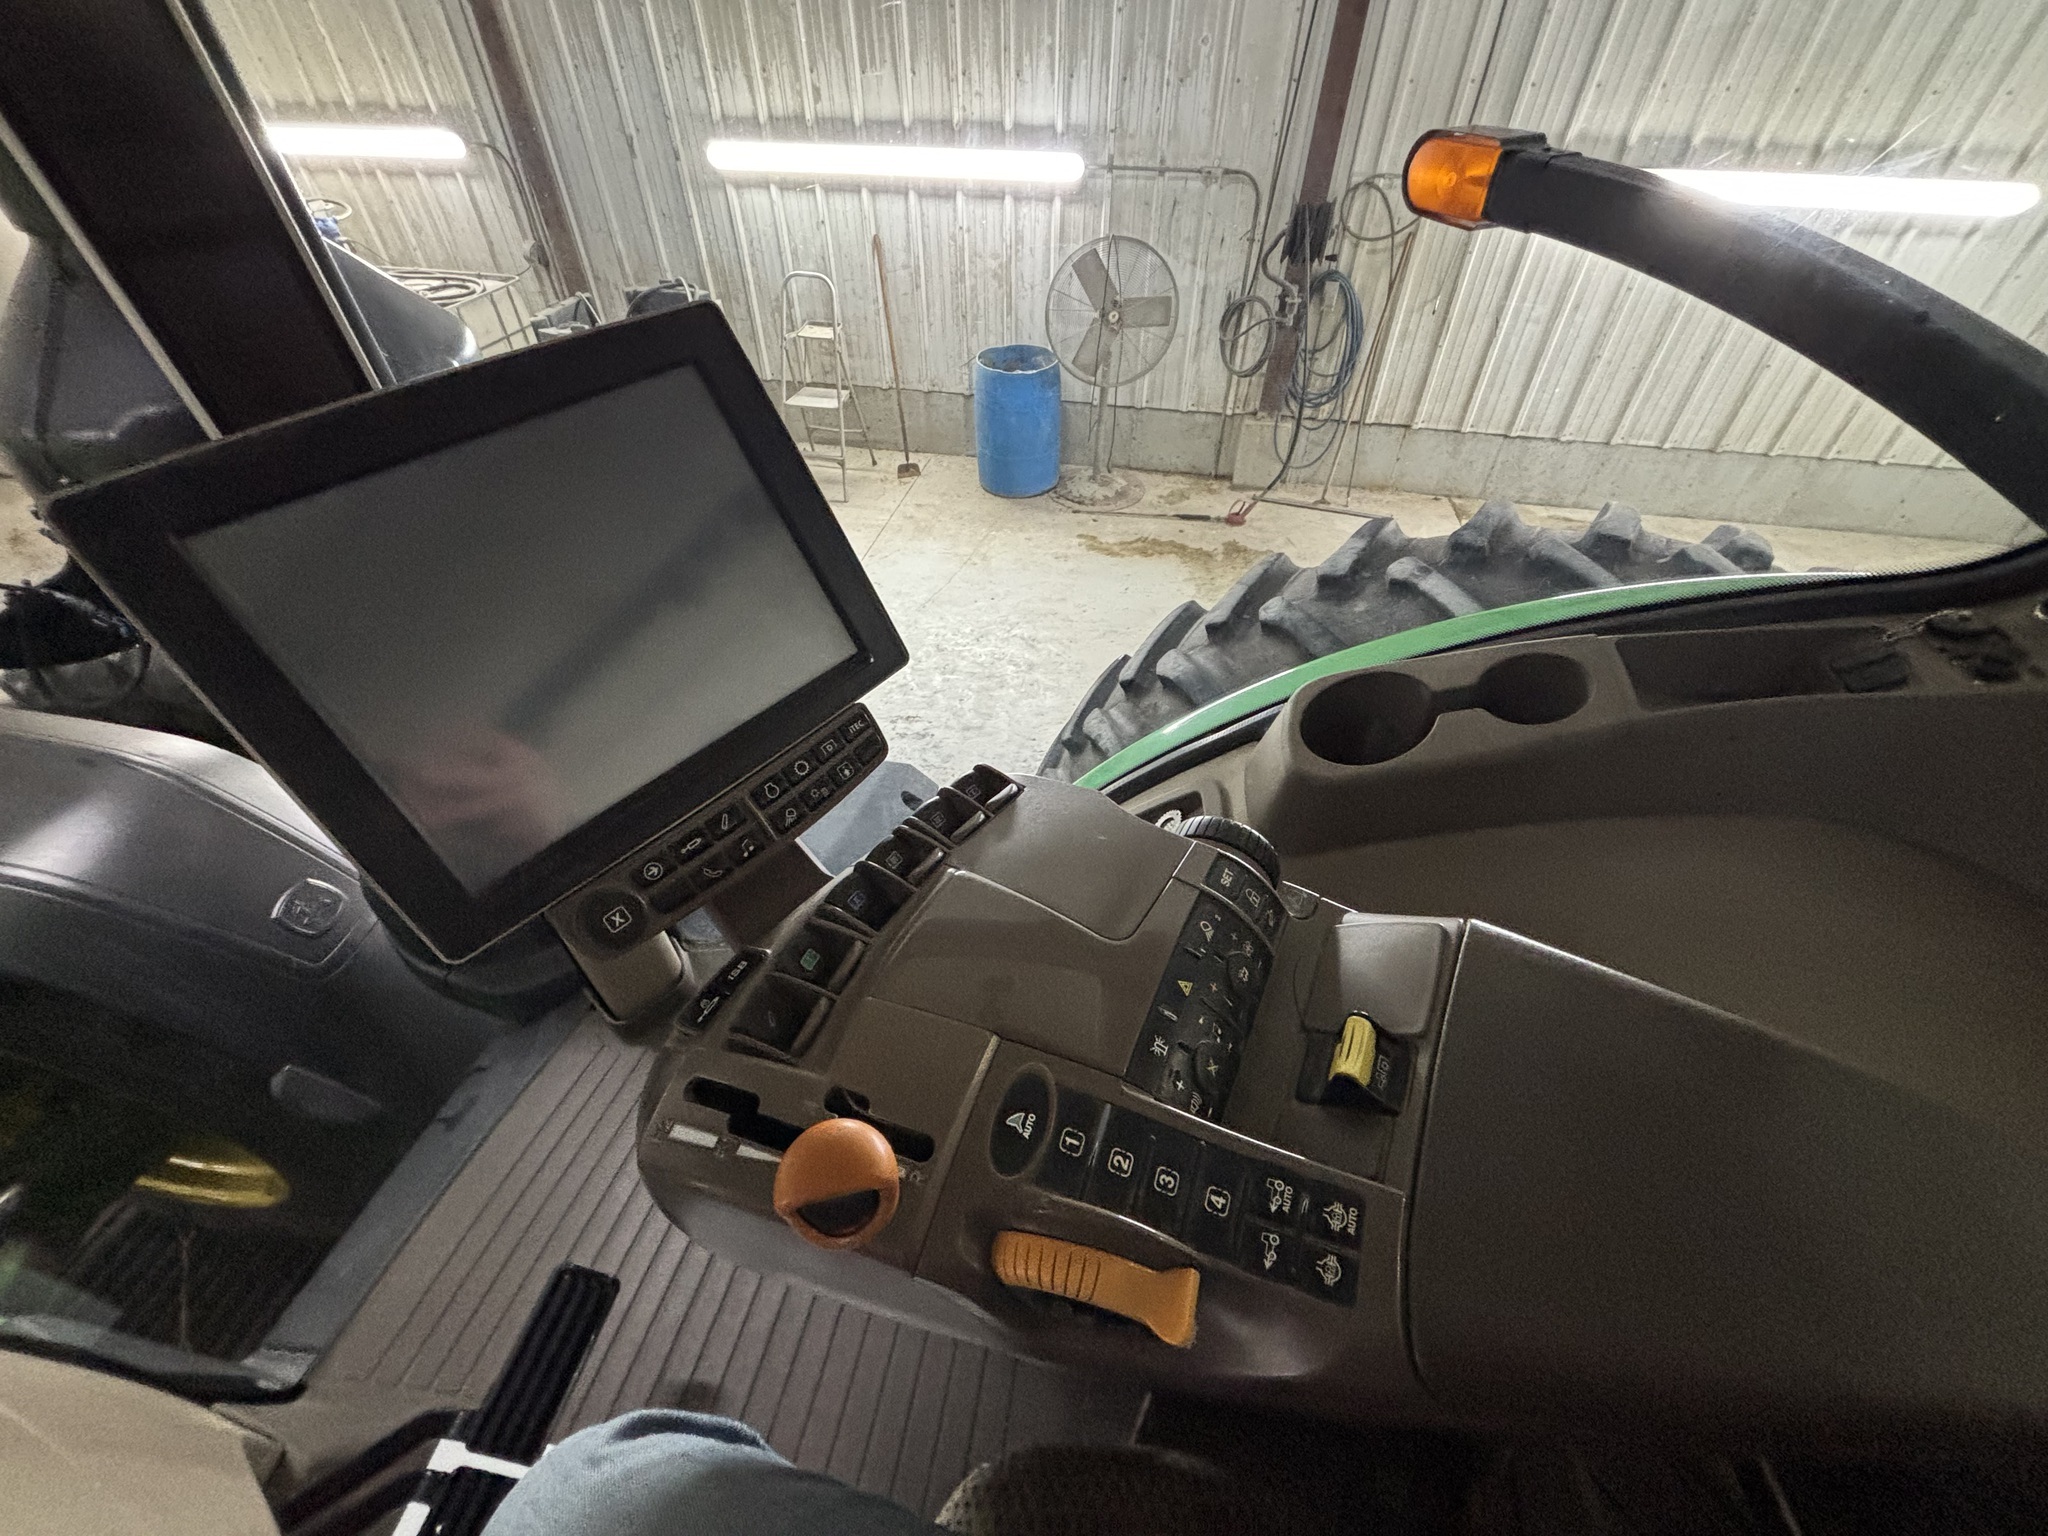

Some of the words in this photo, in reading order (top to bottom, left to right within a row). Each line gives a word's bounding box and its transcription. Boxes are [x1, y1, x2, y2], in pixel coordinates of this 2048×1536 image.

[1221, 868, 1235, 887] SET
[1022, 1113, 1036, 1140] AUTO
[1065, 1136, 1080, 1147] 1
[1113, 1155, 1129, 1170] 2
[1159, 1174, 1175, 1189] 3
[1210, 1193, 1226, 1208] 4
[1282, 1186, 1294, 1213] AUTO
[1347, 1207, 1358, 1235] AUTO
